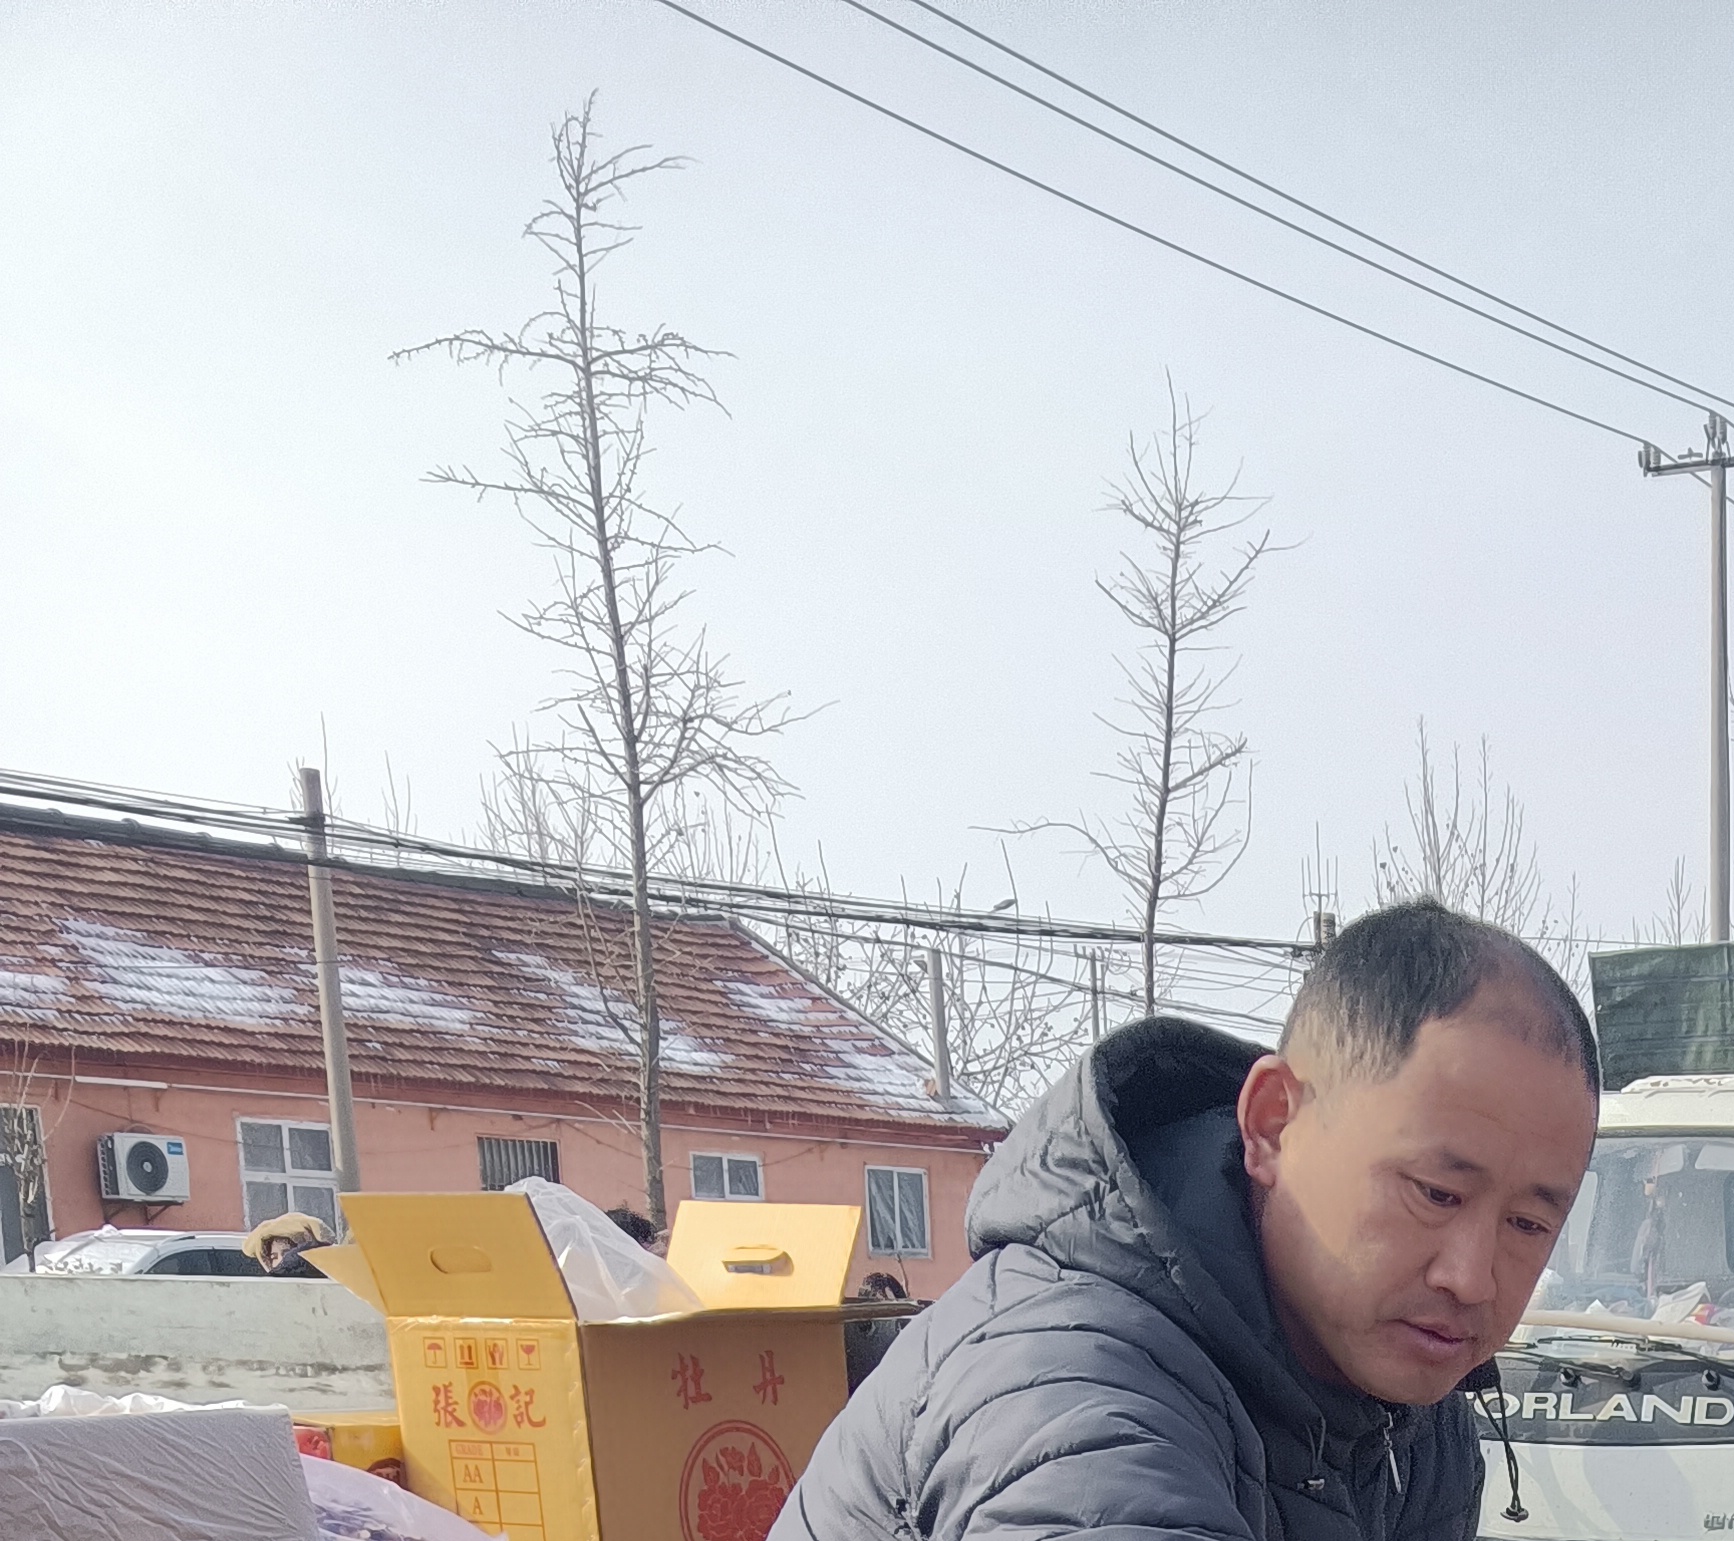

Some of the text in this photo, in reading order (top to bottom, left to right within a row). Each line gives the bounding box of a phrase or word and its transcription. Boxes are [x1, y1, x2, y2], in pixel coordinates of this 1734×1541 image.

[671, 1350, 785, 1410] 牡丹
[432, 1382, 546, 1429] 張記
[463, 1463, 485, 1484] AA
[472, 1496, 484, 1516] A
